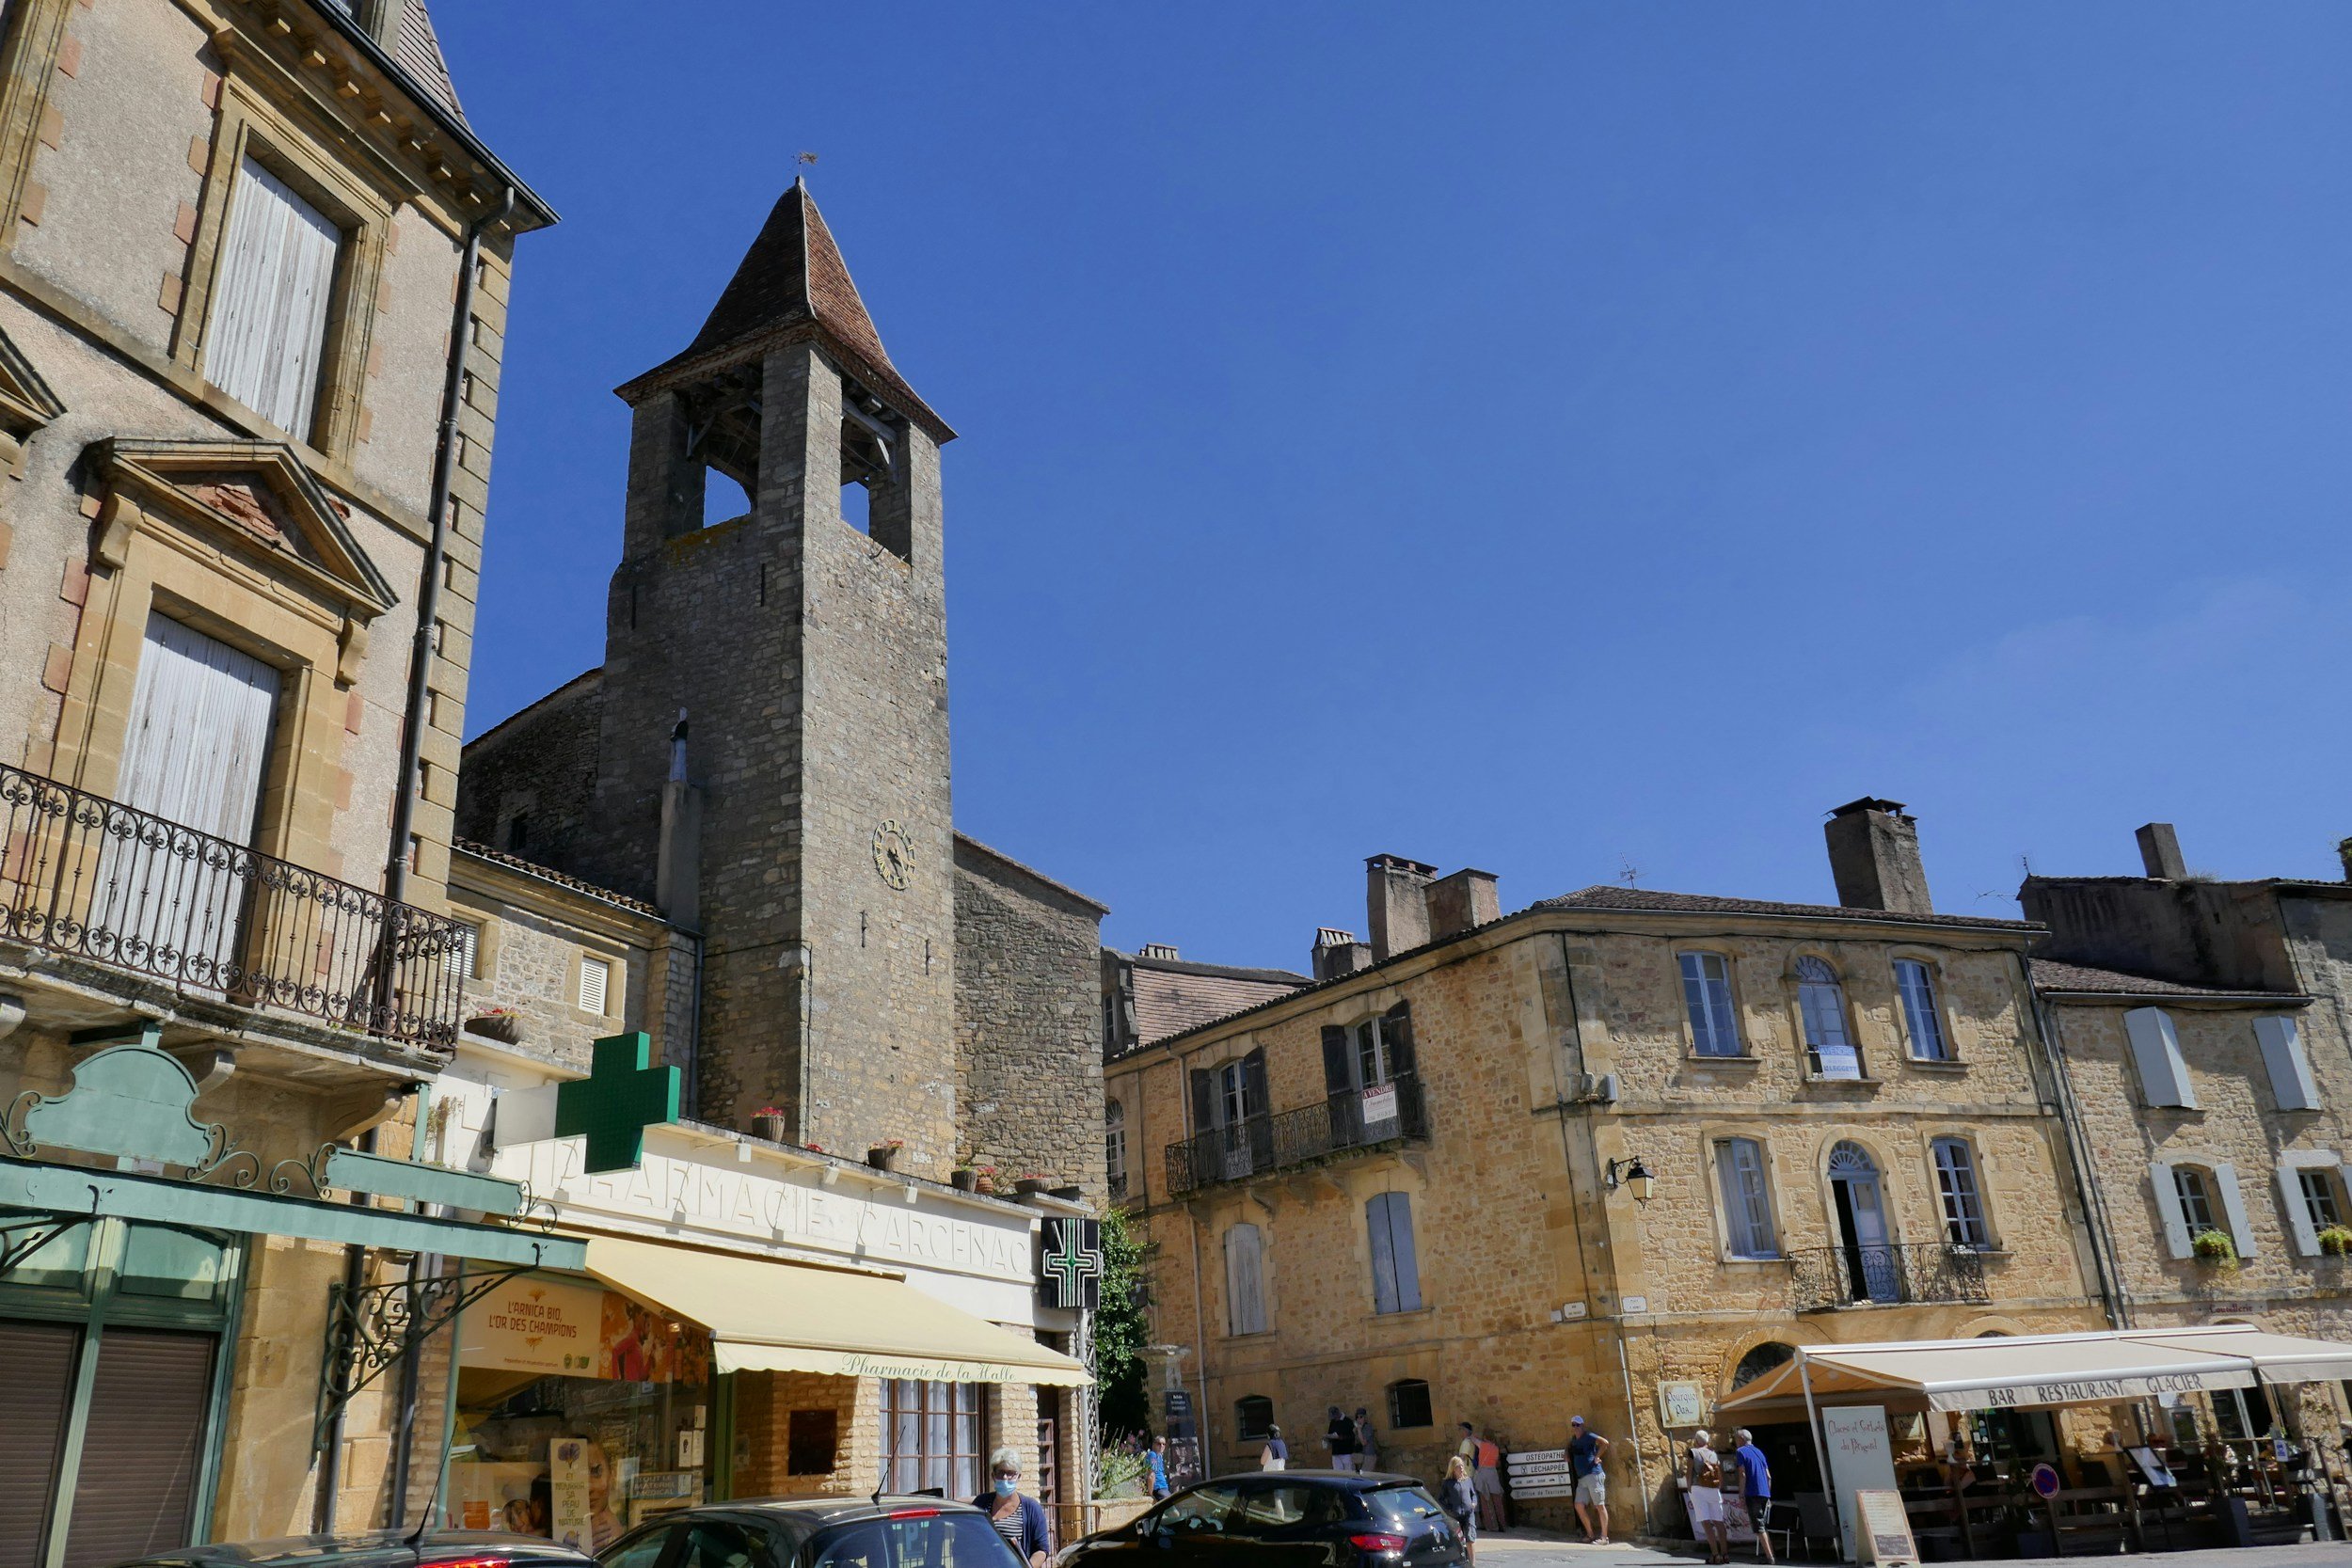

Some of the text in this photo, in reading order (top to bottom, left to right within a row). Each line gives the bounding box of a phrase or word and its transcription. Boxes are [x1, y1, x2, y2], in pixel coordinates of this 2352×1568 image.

[1368, 1084, 1393, 1098] VENDRE
[508, 1301, 563, 1323] L'ARNICA BIO,
[489, 1315, 577, 1338] L'OR DES CHAMPIONS
[841, 1354, 1016, 1381] Pharmacie de la Halle
[1988, 1373, 2204, 1407] BAR RESTAURANT GLACIER
[565, 1491, 576, 1499] SA
[562, 1499, 580, 1509] PEAU
[566, 1509, 576, 1518] DE
[557, 1518, 585, 1527] NATURE
